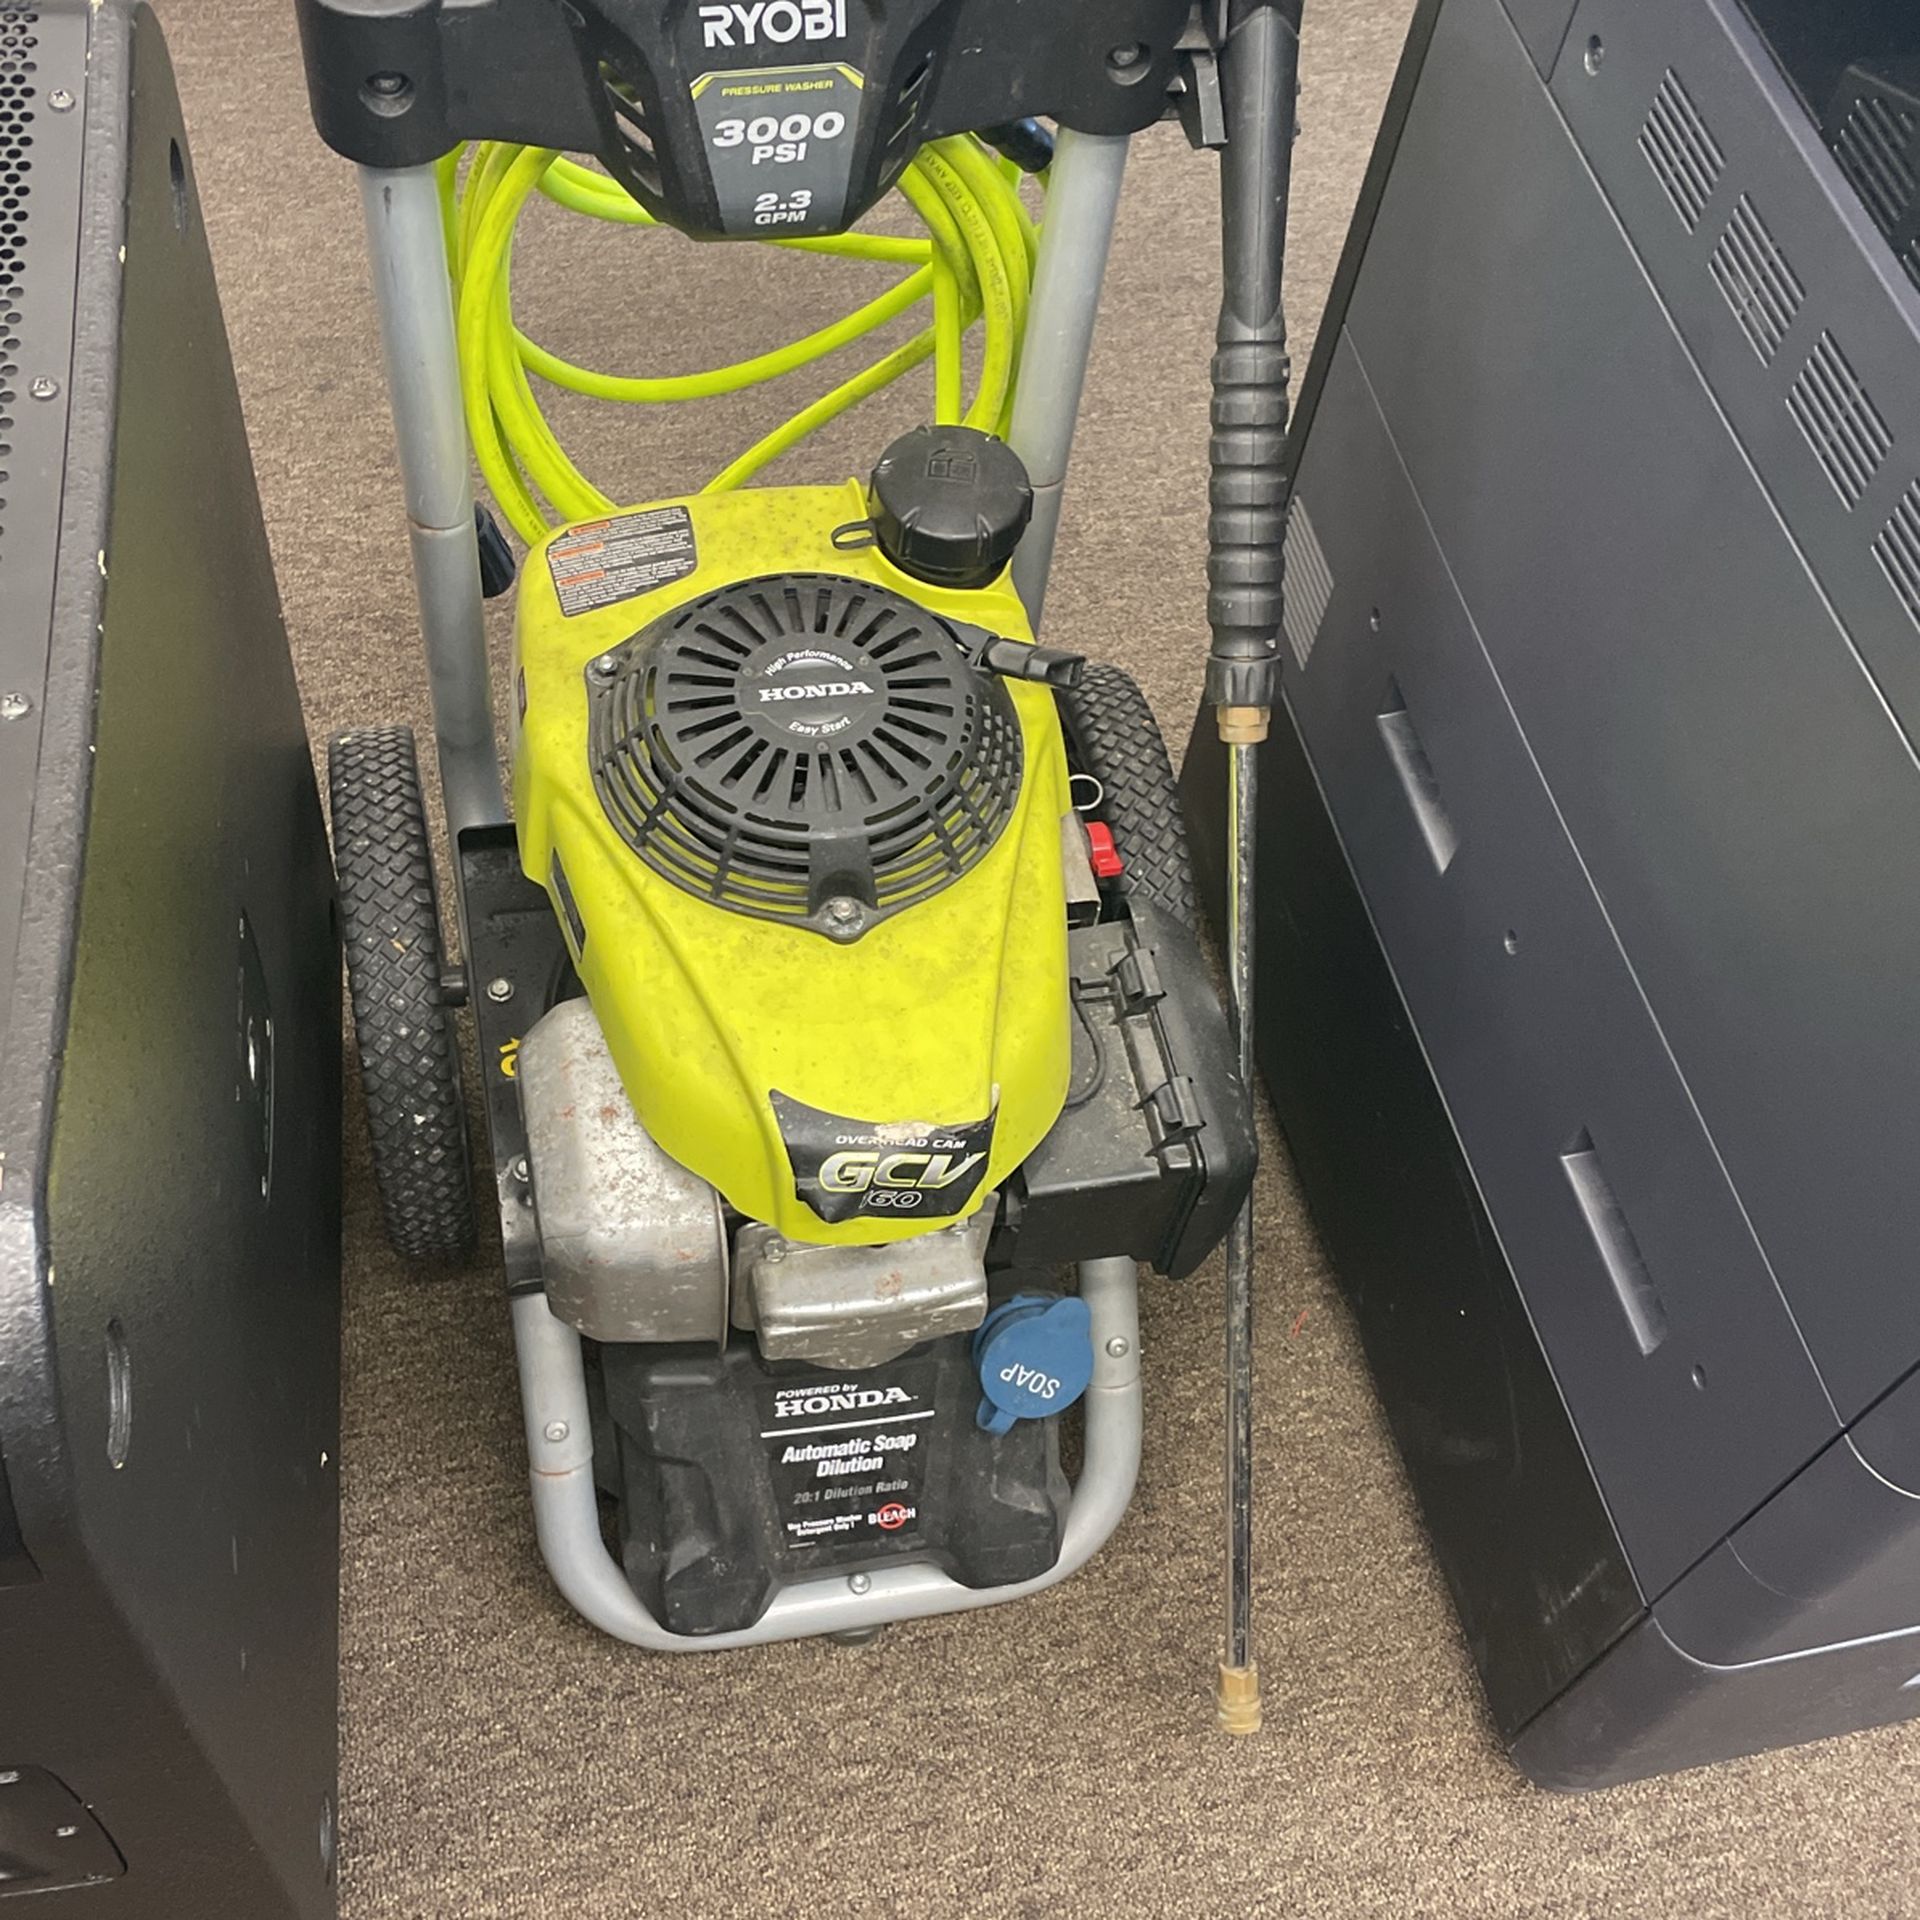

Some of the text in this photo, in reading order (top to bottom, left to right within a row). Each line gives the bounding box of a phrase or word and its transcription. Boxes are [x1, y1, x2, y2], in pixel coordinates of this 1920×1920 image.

[699, 0, 847, 48] RYOBI
[721, 79, 834, 97] PRESSURE WASHER
[712, 111, 845, 148] 3000
[752, 142, 807, 165] PSI
[753, 190, 813, 213] 2.3
[754, 210, 807, 225] GPM
[764, 649, 854, 677] High Performance
[758, 681, 875, 702] HONDA
[788, 716, 851, 737] Easy Start
[931, 1138, 968, 1149] CAM
[818, 1150, 988, 1193] GCV
[858, 1190, 923, 1210] 160
[776, 1383, 859, 1400] POWERED by
[1000, 1363, 1061, 1400] SOAP
[774, 1387, 912, 1418] HONDA
[781, 1433, 918, 1464] Automatic Soap
[816, 1456, 884, 1478] Dilution
[793, 1478, 909, 1505] 20:1 Dilution Ratio
[867, 1507, 917, 1526] BLEACH
